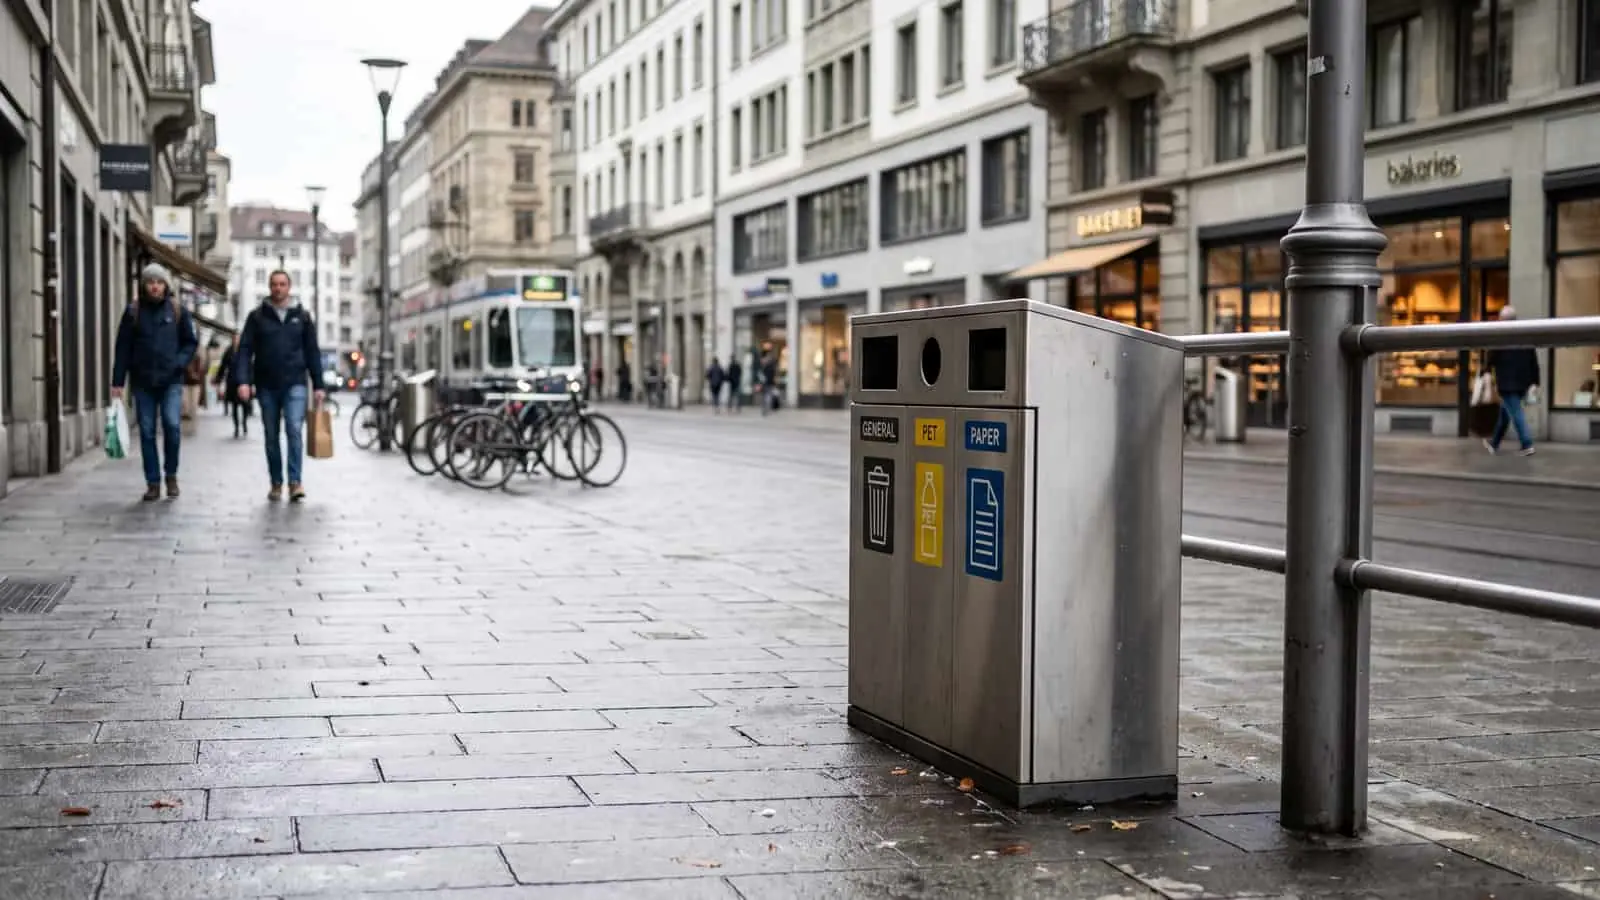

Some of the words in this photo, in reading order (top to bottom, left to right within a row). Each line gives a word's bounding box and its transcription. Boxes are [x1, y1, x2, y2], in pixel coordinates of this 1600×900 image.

[862, 420, 897, 438] GENERAL
[922, 424, 938, 441] PET
[970, 426, 1001, 446] PAPER
